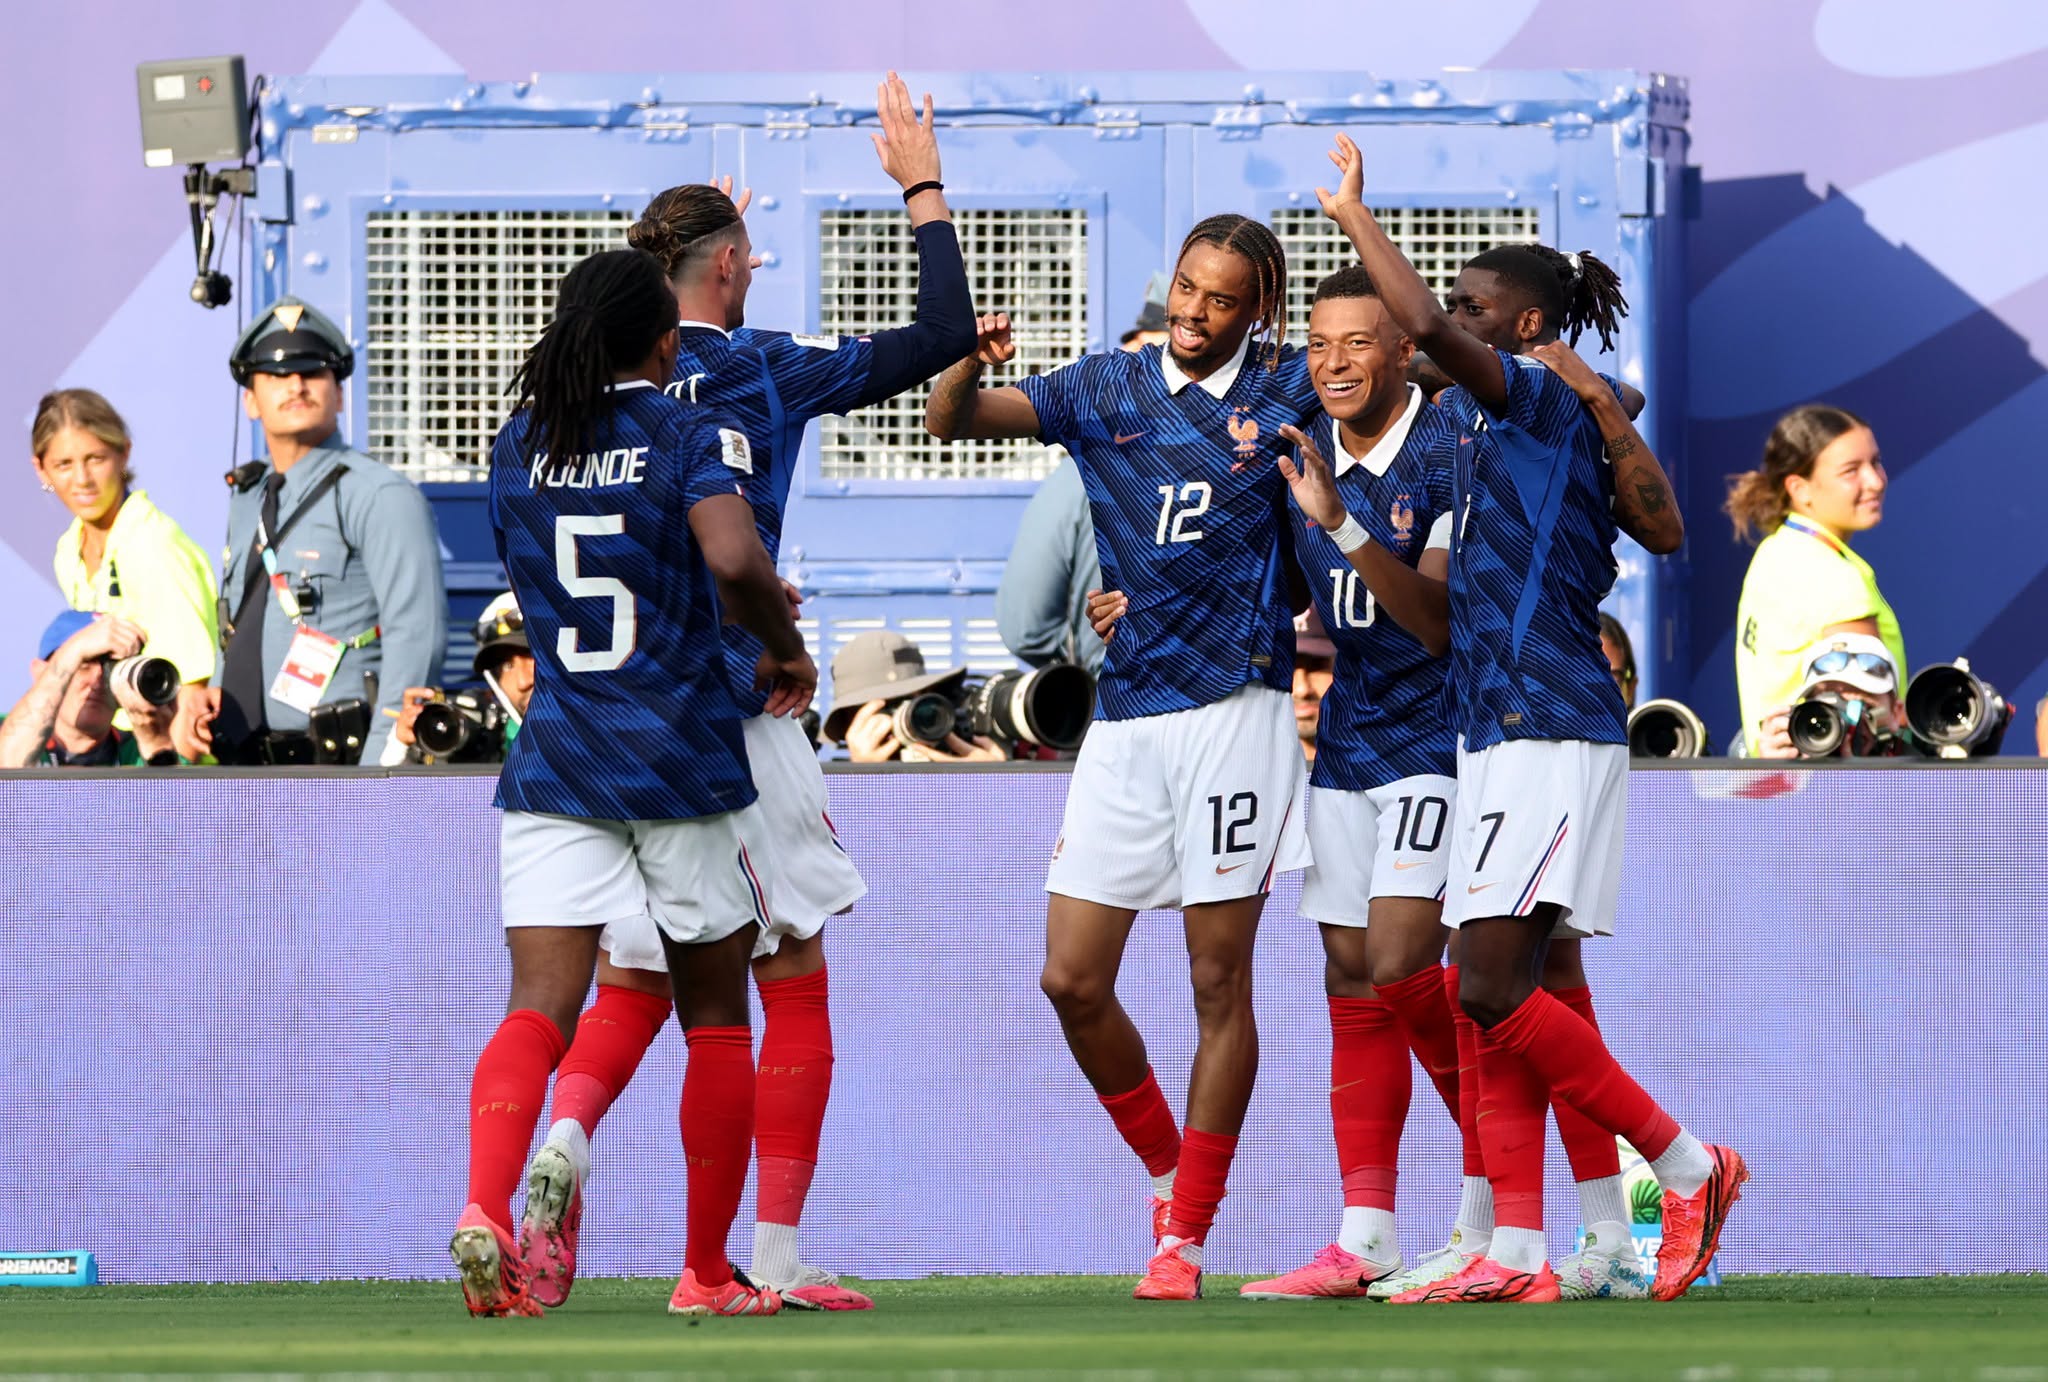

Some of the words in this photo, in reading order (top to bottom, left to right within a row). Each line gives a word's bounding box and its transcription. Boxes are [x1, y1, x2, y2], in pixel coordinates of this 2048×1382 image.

[529, 447, 649, 489] KOUNDE
[1156, 481, 1212, 545] 12
[555, 513, 637, 673] 5
[1329, 568, 1375, 629] 10
[1208, 791, 1258, 855] 12
[1394, 796, 1449, 852] 10
[1475, 811, 1505, 873] 7
[478, 1101, 521, 1118] FFF
